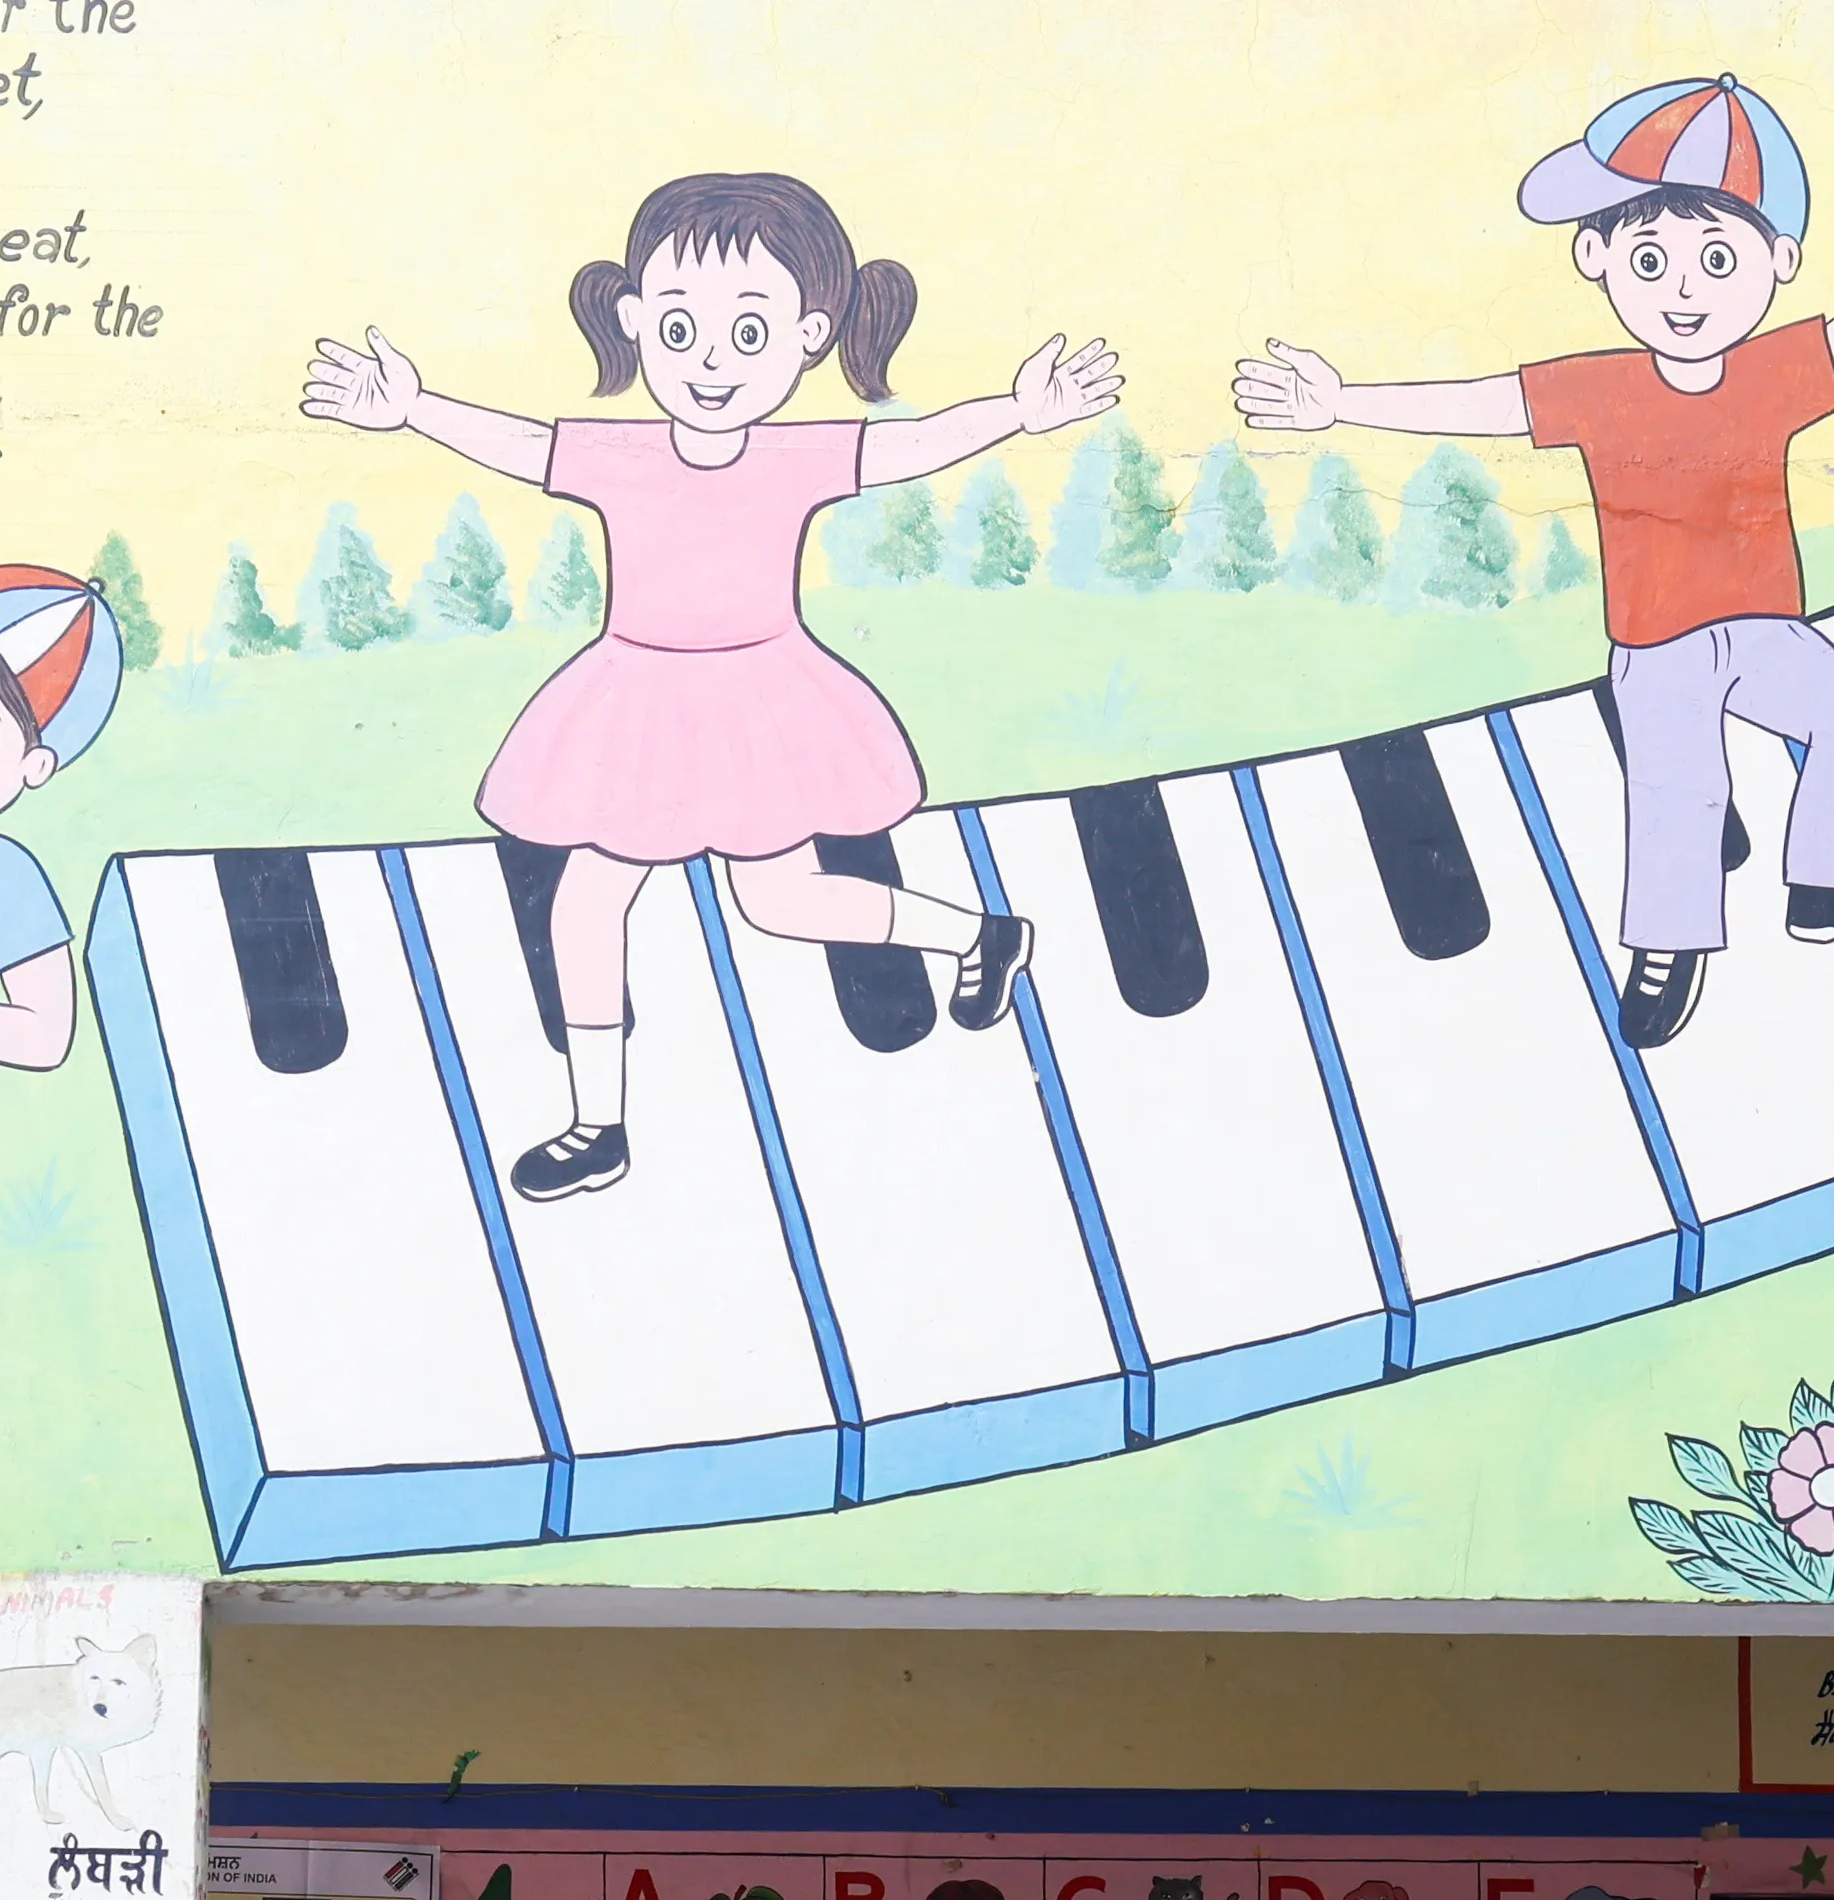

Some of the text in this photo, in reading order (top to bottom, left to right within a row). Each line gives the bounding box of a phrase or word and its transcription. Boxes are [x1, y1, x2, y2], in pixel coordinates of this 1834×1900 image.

[93, 283, 165, 338] the
[223, 1872, 277, 1884] OF INDIA
